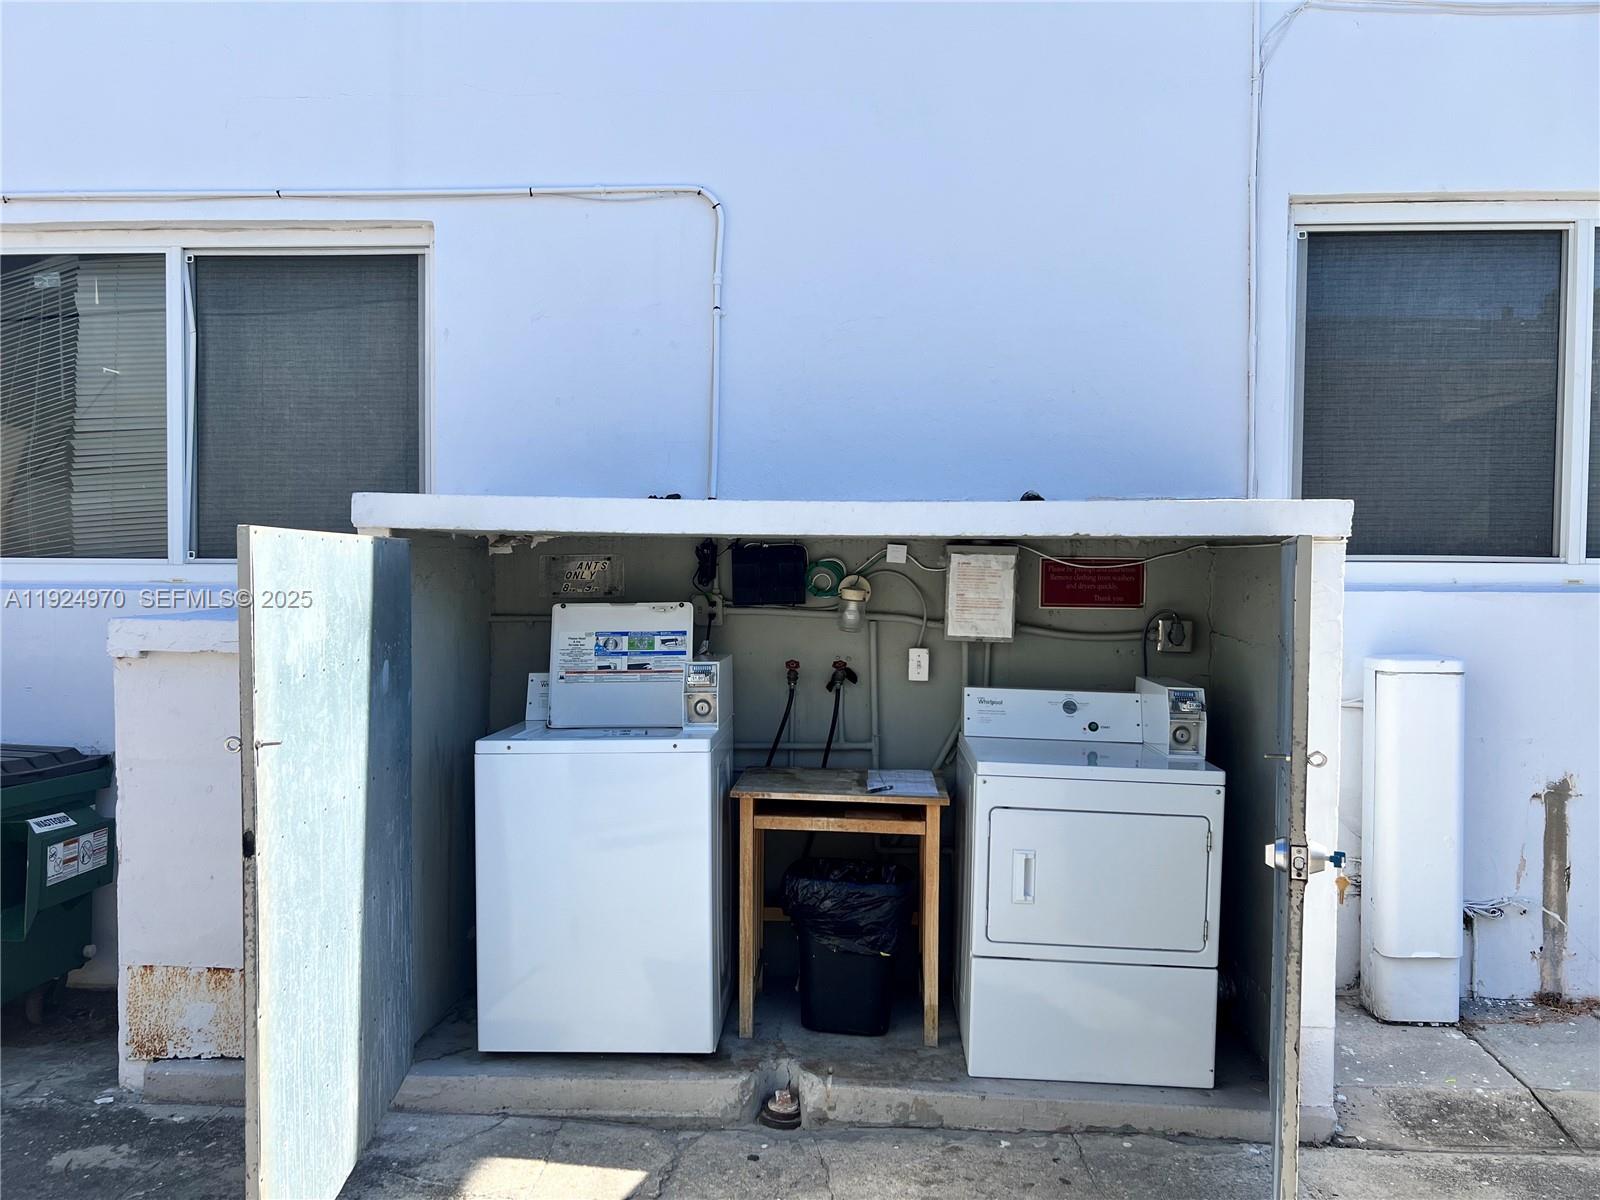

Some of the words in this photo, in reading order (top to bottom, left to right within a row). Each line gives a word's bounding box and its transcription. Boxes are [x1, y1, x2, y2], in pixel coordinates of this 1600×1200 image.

[576, 561, 608, 570] ANTS
[565, 571, 597, 580] ONLY
[977, 696, 1003, 706] Whirlpool
[33, 815, 70, 828] WASTEQUIP
